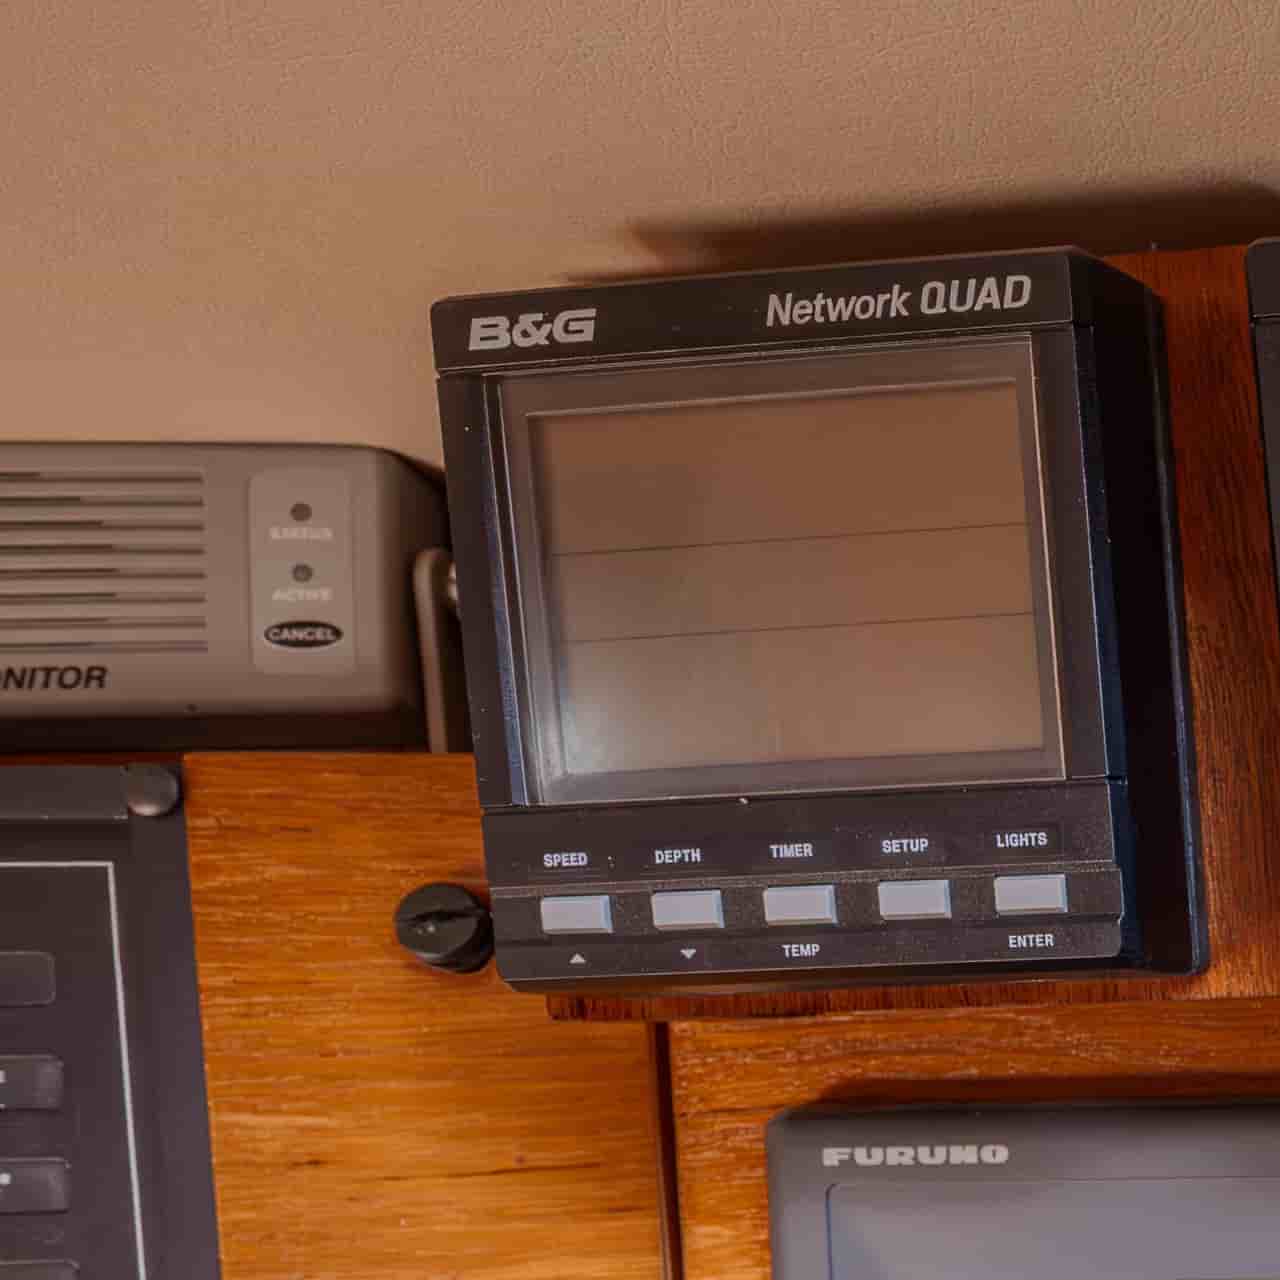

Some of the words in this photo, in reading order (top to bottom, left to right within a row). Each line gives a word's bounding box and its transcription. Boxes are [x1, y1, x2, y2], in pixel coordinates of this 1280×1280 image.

[468, 308, 597, 352] B&G
[764, 284, 911, 328] Network
[919, 274, 1033, 316] QUAD
[267, 626, 336, 642] CANCEL
[0, 664, 109, 692] NITOR
[881, 837, 929, 855] SETUP
[995, 831, 1048, 849] LIGHTS
[543, 851, 589, 869] SPEED
[655, 847, 702, 865] DEPTH
[769, 842, 814, 860] TIMER
[1008, 932, 1055, 950] ENTER
[782, 942, 821, 960] TEMP
[821, 1144, 1010, 1168] FURUNO
